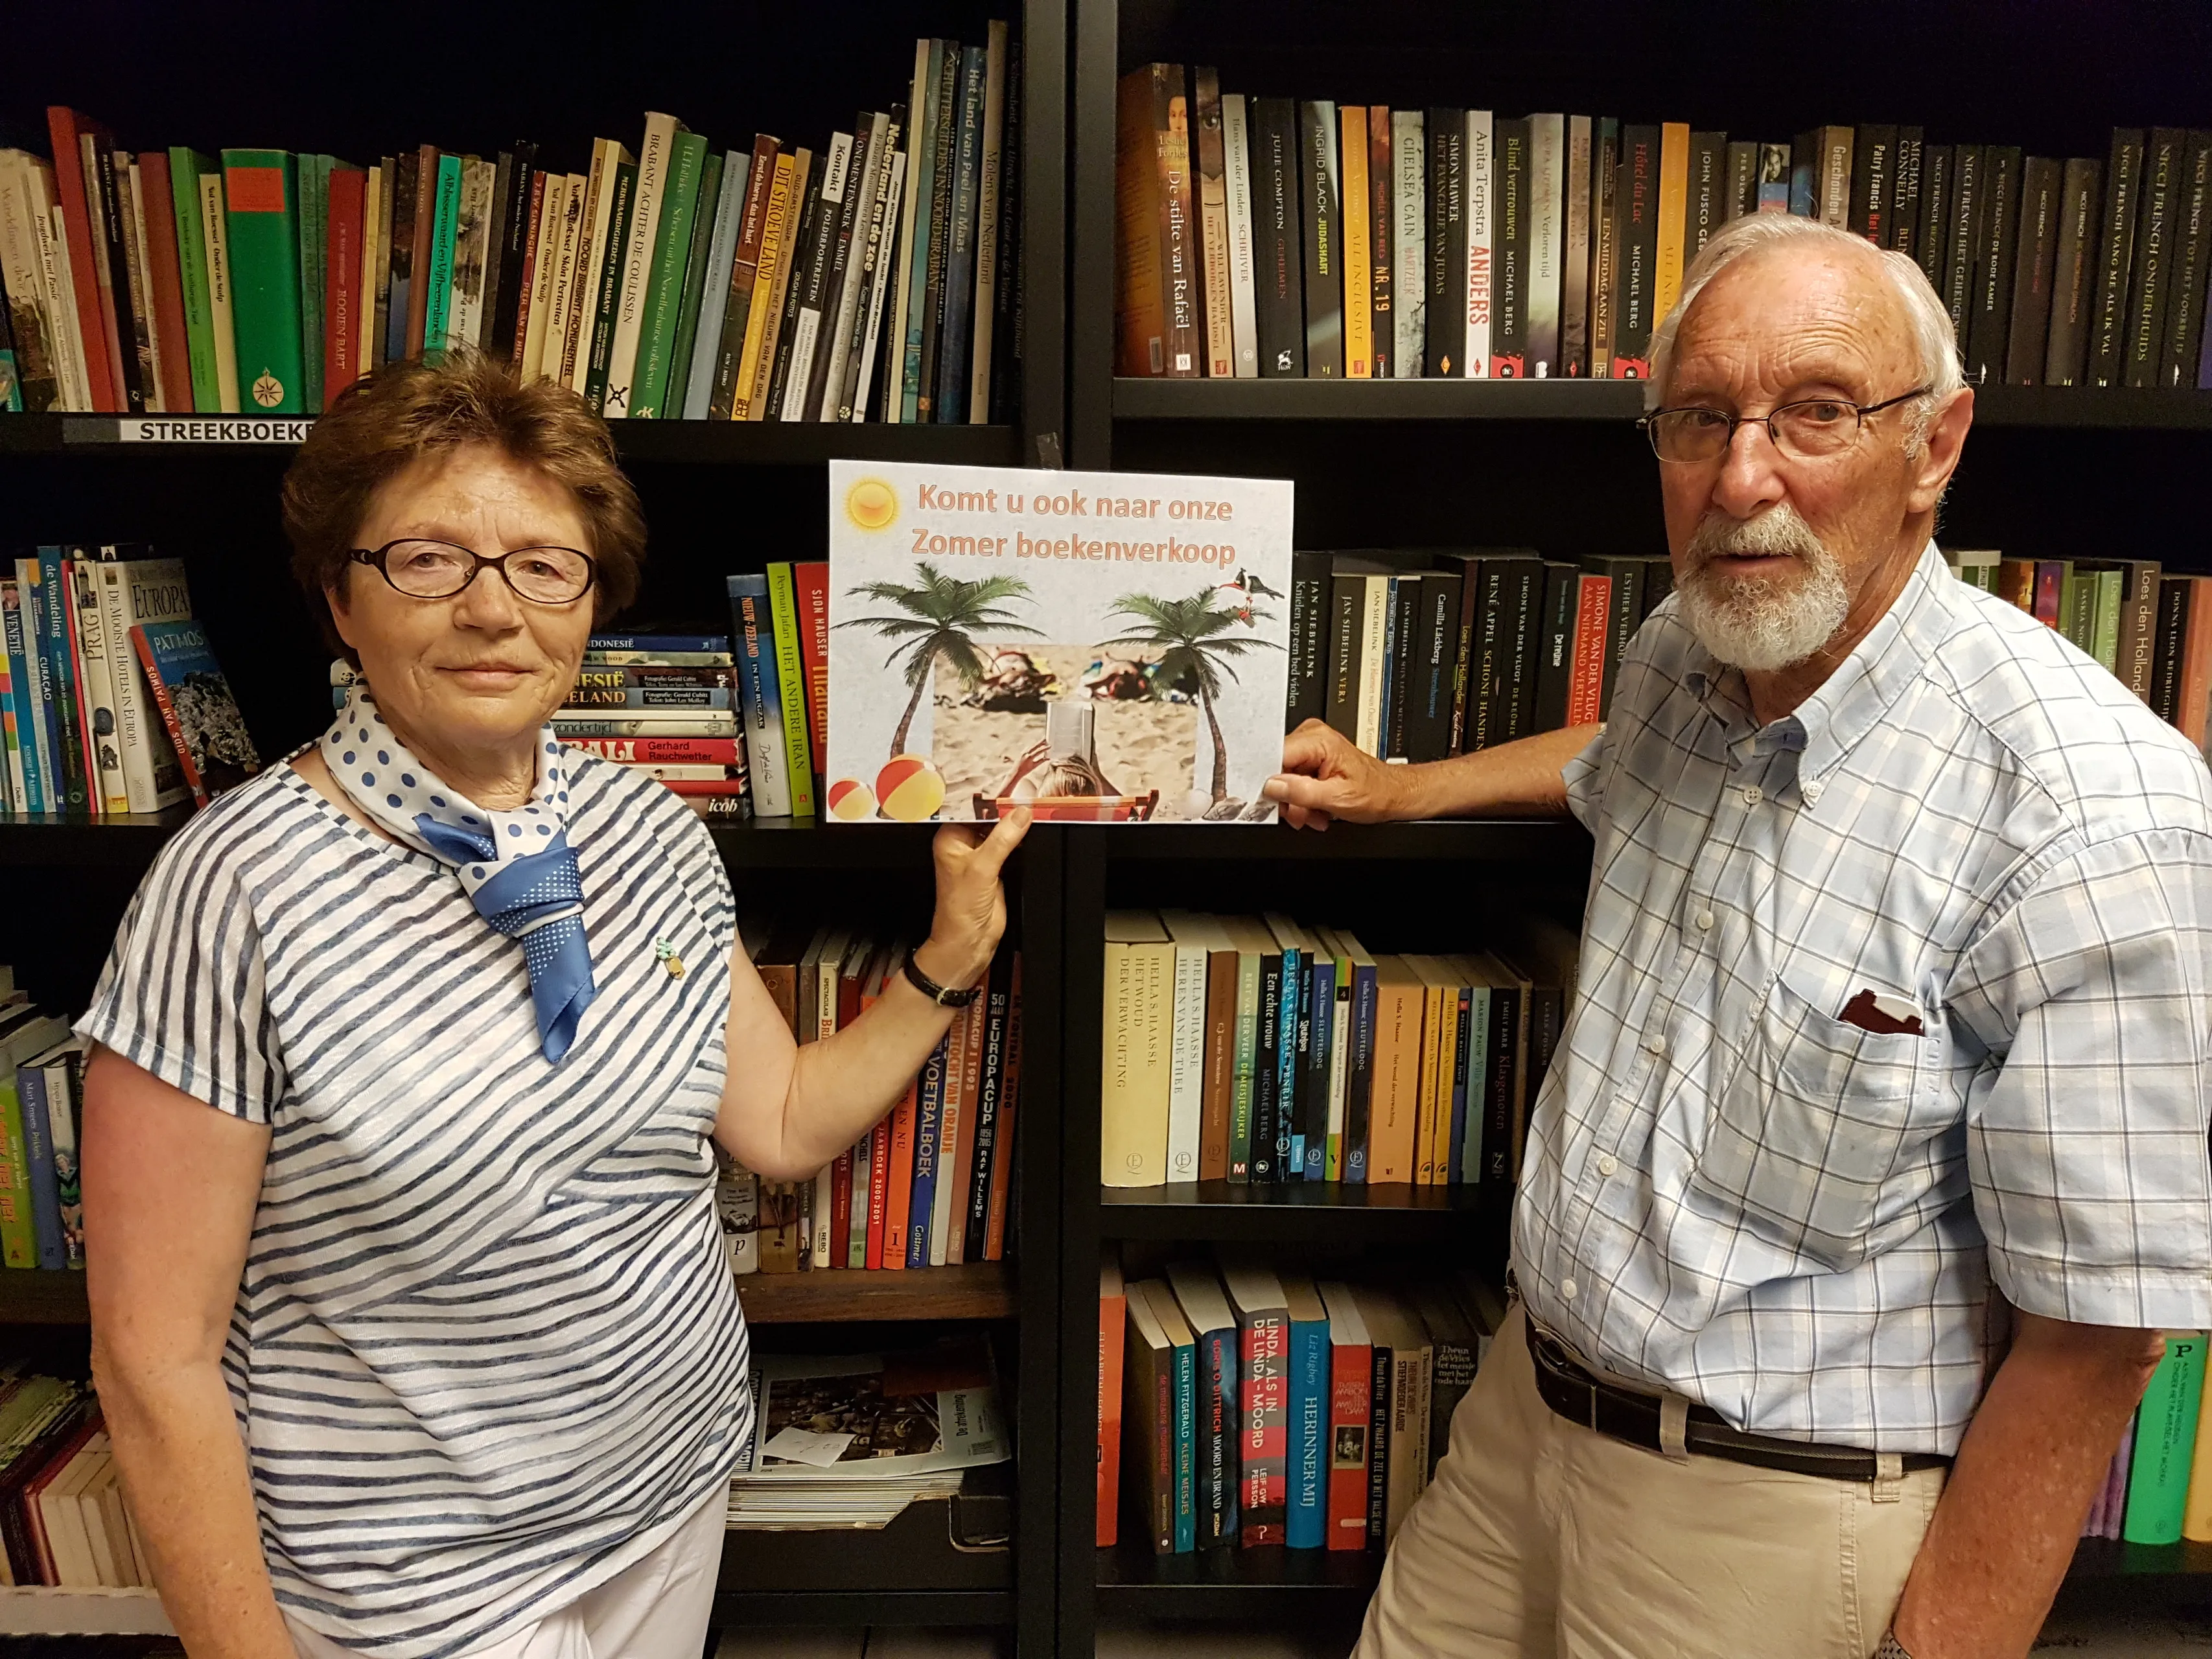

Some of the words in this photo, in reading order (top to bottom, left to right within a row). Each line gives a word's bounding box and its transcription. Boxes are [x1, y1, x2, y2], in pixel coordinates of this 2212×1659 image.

[967, 69, 979, 93] Het
[964, 97, 977, 127] land
[962, 132, 972, 157] van
[1231, 118, 1240, 143] Hans
[1315, 126, 1325, 168] INGRID
[643, 133, 660, 189] BRABANT
[876, 123, 900, 202] Nederland
[1271, 133, 1281, 166] JULIE
[1449, 135, 1459, 174] SIMON
[1476, 130, 1487, 170] Anita
[1508, 138, 1520, 170] Blind
[1870, 145, 1885, 170] Patry
[2156, 145, 2169, 187] NICCI
[774, 166, 791, 189] DIT
[828, 143, 846, 192] Kontakt
[960, 162, 972, 191] Peel
[1168, 170, 1182, 193] De
[1234, 165, 1243, 180] der
[1404, 138, 1414, 198] CHELSEA
[1826, 145, 1847, 215] Geschonden
[1895, 140, 1909, 211] CONNELLY
[1907, 141, 1920, 201] MICHAEL
[959, 196, 967, 212] en
[1235, 183, 1245, 215] Linden
[1274, 169, 1284, 229] COMPTON
[1316, 172, 1326, 213] BLACK
[1449, 178, 1459, 222] MAWER
[1473, 174, 1487, 235] Terpstra
[1505, 174, 1517, 239] vertrouwen
[1869, 174, 1883, 210] Francis
[437, 173, 455, 248] Alblasserwaard
[635, 191, 651, 237] ACHTER
[763, 189, 787, 245] STROEVE
[872, 203, 883, 223] en
[1169, 199, 1184, 239] stilte
[1404, 204, 1414, 236] CAIN
[2148, 192, 2164, 255] FRENCH
[633, 240, 644, 257] DE
[868, 223, 882, 244] de
[956, 217, 968, 253] Maas
[1317, 217, 1327, 275] JUDASHART
[757, 246, 776, 281] LAND
[809, 208, 832, 302] POLDERPORTRETTEN
[863, 244, 876, 272] zee
[1172, 245, 1182, 272] van
[1237, 223, 1249, 281] SCHRIJVER
[622, 259, 641, 324] COULISSEN
[1375, 266, 1390, 290] NR.
[1469, 246, 1489, 325] ANDERS
[1506, 251, 1514, 302] MICHAEL
[1174, 279, 1189, 328] Rafaël
[1375, 294, 1390, 311] 19
[2137, 259, 2158, 361] ONDERHUIDS
[1504, 307, 1513, 334] BERG
[918, 483, 998, 513] Komt
[1006, 494, 1025, 514] u
[1033, 489, 1088, 516] ook
[1096, 498, 1161, 520] naar
[1168, 500, 1233, 521] onze
[911, 529, 1008, 559] Zomer
[1016, 532, 1236, 570] boekenverkoop
[45, 563, 56, 578] de
[2140, 569, 2154, 600] Loes
[46, 580, 64, 638] Wandeling
[108, 590, 119, 604] DE
[774, 575, 789, 612] Peyman
[1294, 581, 1305, 619] Knielen
[1309, 581, 1318, 603] JAN
[1436, 594, 1446, 625] Camilla
[1583, 585, 1592, 609] AAN
[1593, 585, 1605, 631] SIMONE
[6, 614, 24, 656] VENETIË
[110, 607, 125, 652] MOOISTE
[778, 614, 791, 639] Jafari
[1290, 622, 1300, 635] op
[2137, 605, 2152, 632] den
[81, 613, 103, 662] PRAG
[154, 629, 204, 655] PATMOS
[1306, 609, 1316, 678] SIEBELINK
[1430, 627, 1443, 664] Läckberg
[1578, 613, 1590, 666] NIEMAND
[1590, 636, 1601, 658] VAN
[116, 655, 131, 693] HOTELS
[782, 646, 795, 674] HET
[1290, 657, 1300, 675] bed
[1588, 663, 1598, 684] DER
[38, 656, 52, 700] CURAÇAO
[1289, 677, 1299, 706] violen
[122, 696, 132, 706] IN
[786, 679, 801, 733] ANDERE
[1572, 670, 1585, 726] VERTELLEN
[1584, 688, 1595, 723] VLUG
[123, 708, 138, 747] EUROPA
[553, 721, 612, 734] zondertijd
[647, 741, 690, 750] Gerhard
[649, 752, 712, 761] Rauchwetter
[792, 737, 804, 770] IRAN
[1119, 958, 1130, 984] DER
[1134, 958, 1144, 984] HET
[1148, 958, 1159, 999] HELLA
[1266, 972, 1277, 991] Een
[991, 993, 1005, 1006] 50
[1133, 987, 1143, 1027] WOUD
[1265, 993, 1278, 1017] echte
[1115, 987, 1129, 1087] VERWACHTING
[1147, 1015, 1158, 1067] HAASSE
[1263, 1019, 1274, 1049] vrouw
[982, 1018, 1001, 1125] EUROPACUP
[1240, 1063, 1247, 1073] DE
[916, 1055, 940, 1178] VOETBALBOEK
[1236, 1076, 1247, 1139] MEISJESKIJKER
[876, 1127, 884, 1174] JAARBOEK
[873, 1179, 881, 1224] 2000-2001
[975, 1172, 987, 1218] WILLEMS
[911, 1224, 923, 1260] Gottmer
[1253, 1319, 1264, 1338] DE
[1309, 1334, 1318, 1349] Liz
[1265, 1367, 1277, 1390] ALS
[1306, 1352, 1318, 1385] Rigbey
[1265, 1397, 1276, 1411] IN
[1212, 1435, 1221, 1465] MOORD
[1303, 1397, 1316, 1480] HERINNER
[1213, 1468, 1220, 1479] EN
[1212, 1481, 1220, 1508] BRAND
[1259, 1488, 1266, 1502] GW
[1299, 1483, 1315, 1507] MIJ
